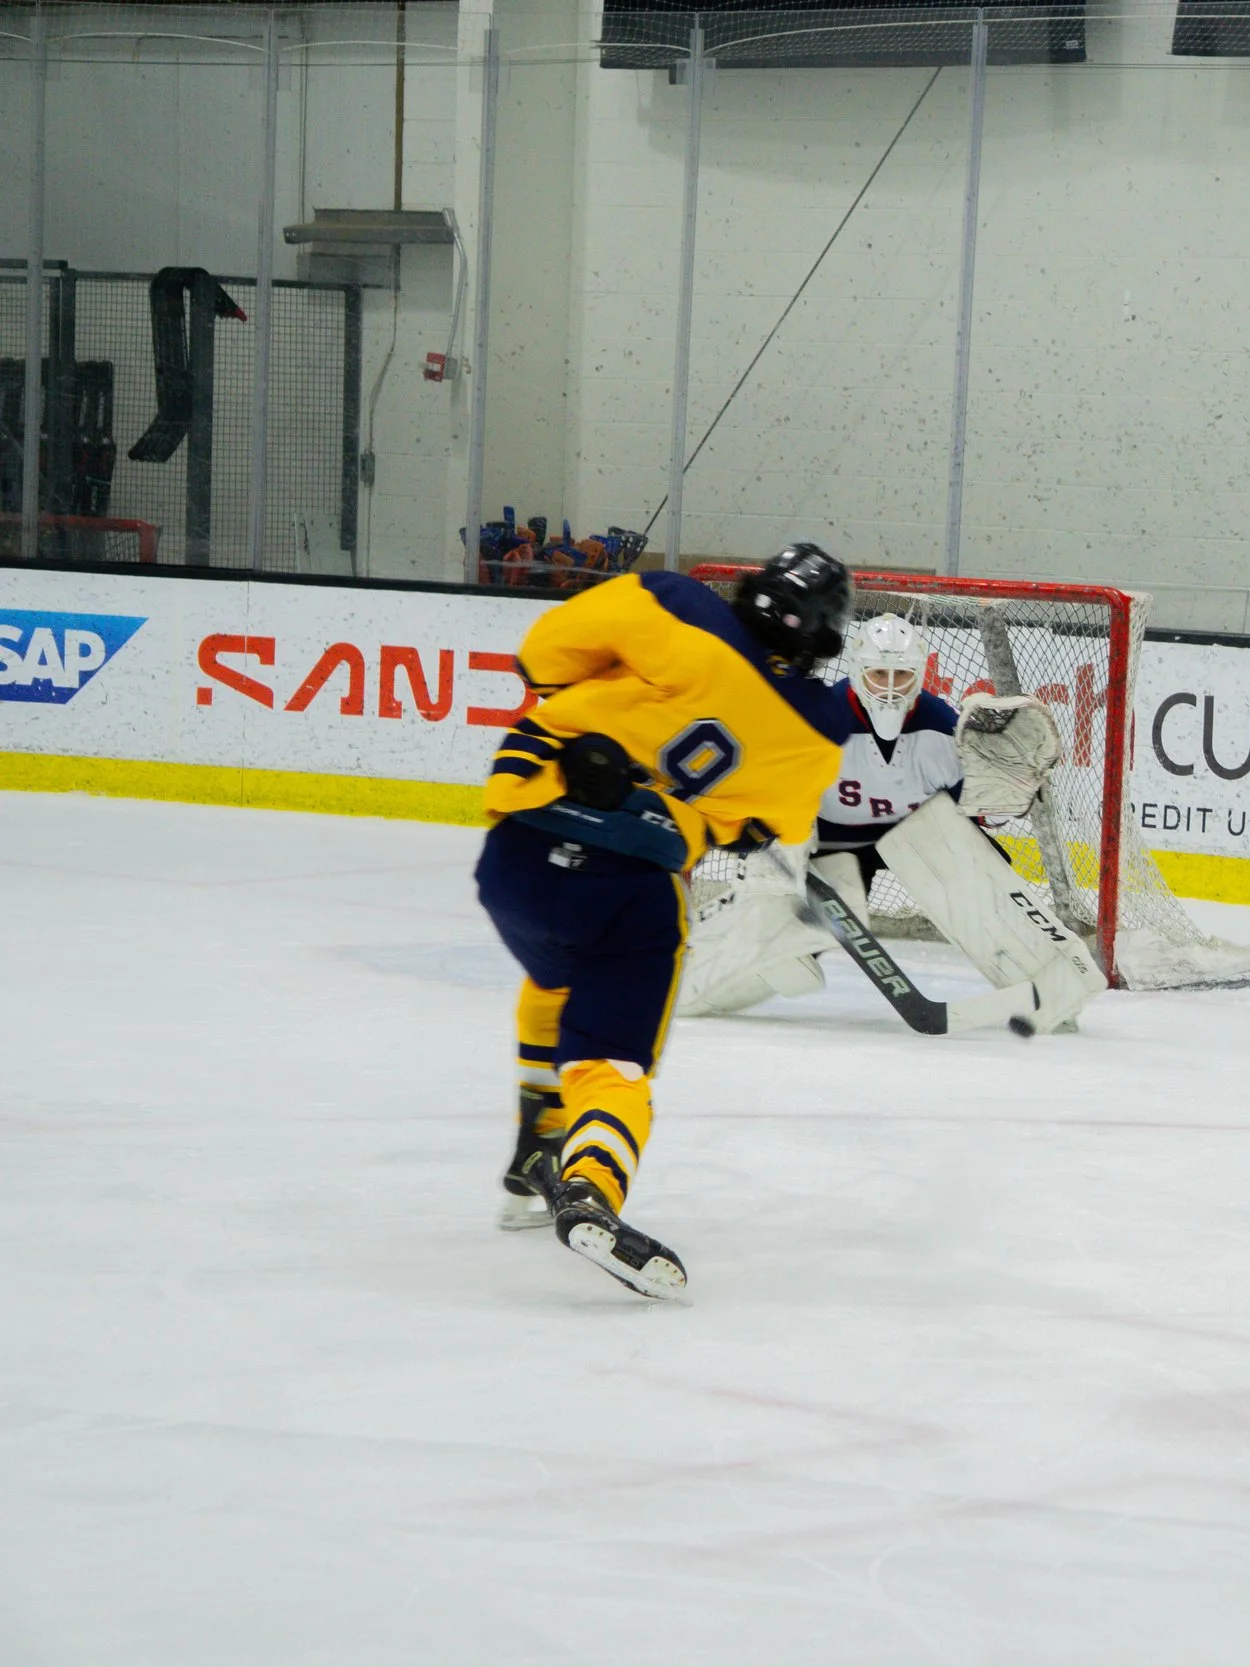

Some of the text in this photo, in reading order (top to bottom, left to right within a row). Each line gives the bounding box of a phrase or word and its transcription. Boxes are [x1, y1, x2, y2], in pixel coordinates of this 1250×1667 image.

[0, 624, 106, 689] SAP
[1098, 799, 1213, 834] EDIT
[1010, 891, 1067, 942] CCM
